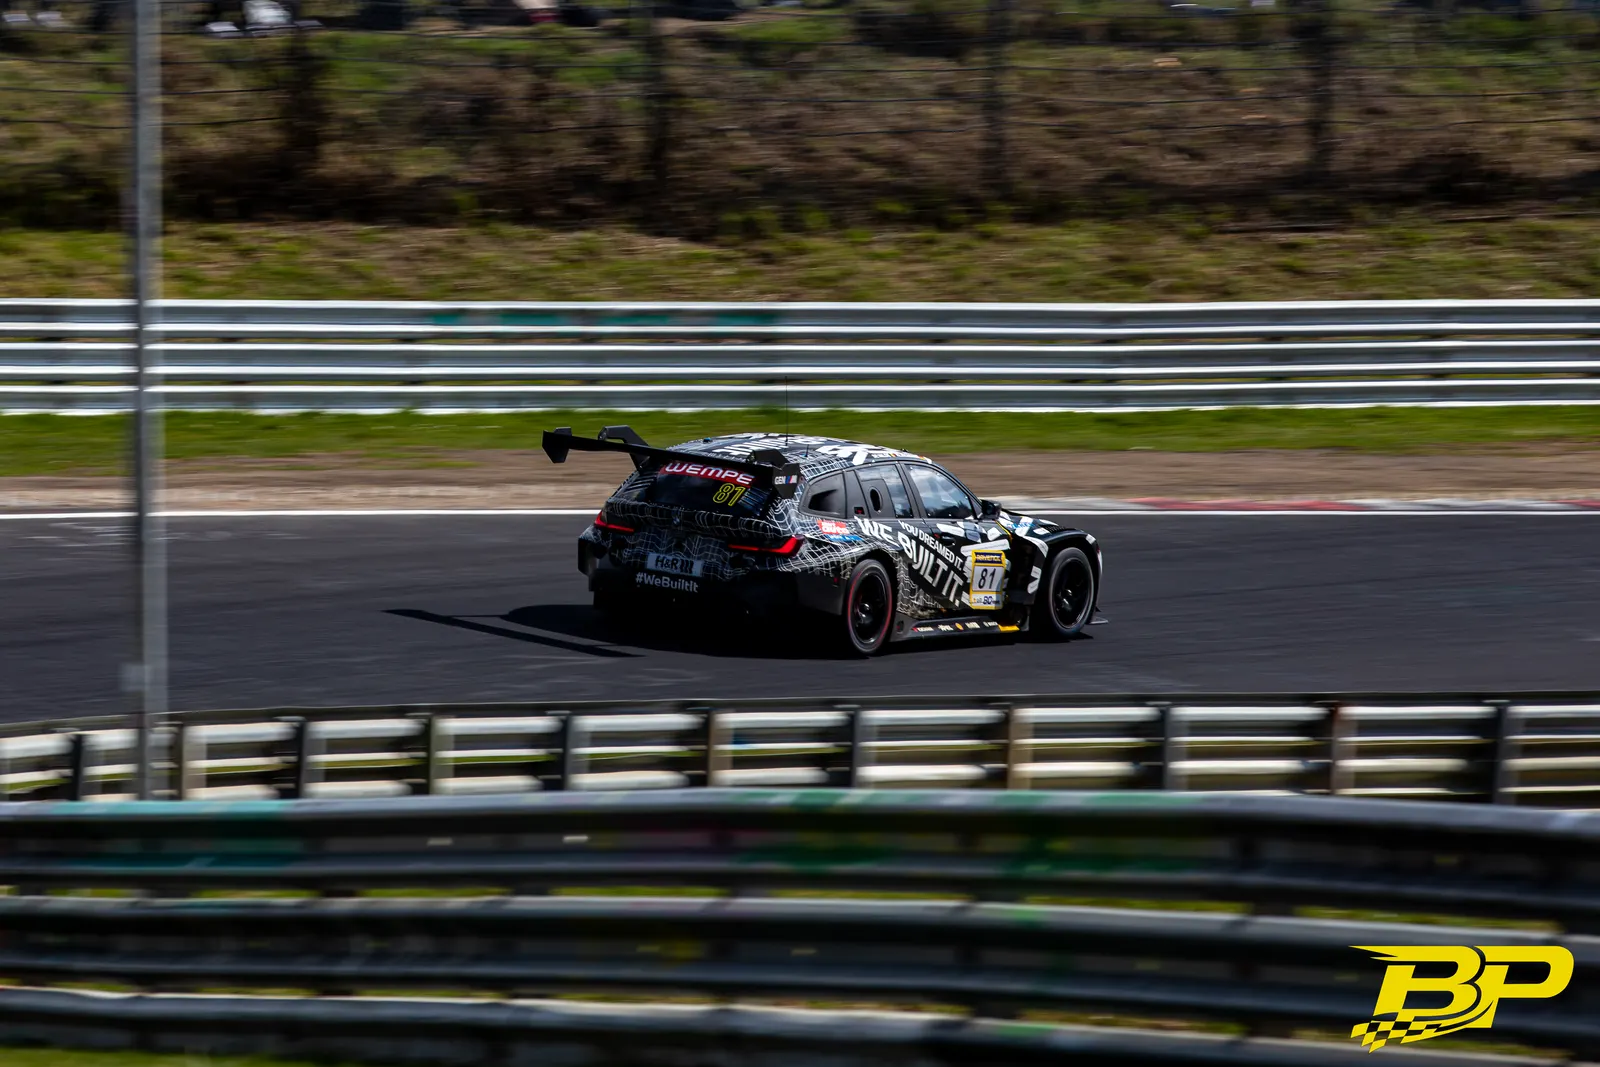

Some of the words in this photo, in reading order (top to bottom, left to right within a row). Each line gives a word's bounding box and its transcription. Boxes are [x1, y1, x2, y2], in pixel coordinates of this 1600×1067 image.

[664, 462, 755, 485] WEMPE
[713, 482, 746, 507] 81
[898, 520, 919, 537] YOU
[918, 529, 955, 563] DREAMED
[953, 556, 964, 571] IT.
[853, 515, 901, 548] WE
[898, 531, 948, 588] BUILT
[941, 570, 964, 608] IT.
[978, 568, 996, 590] 81
